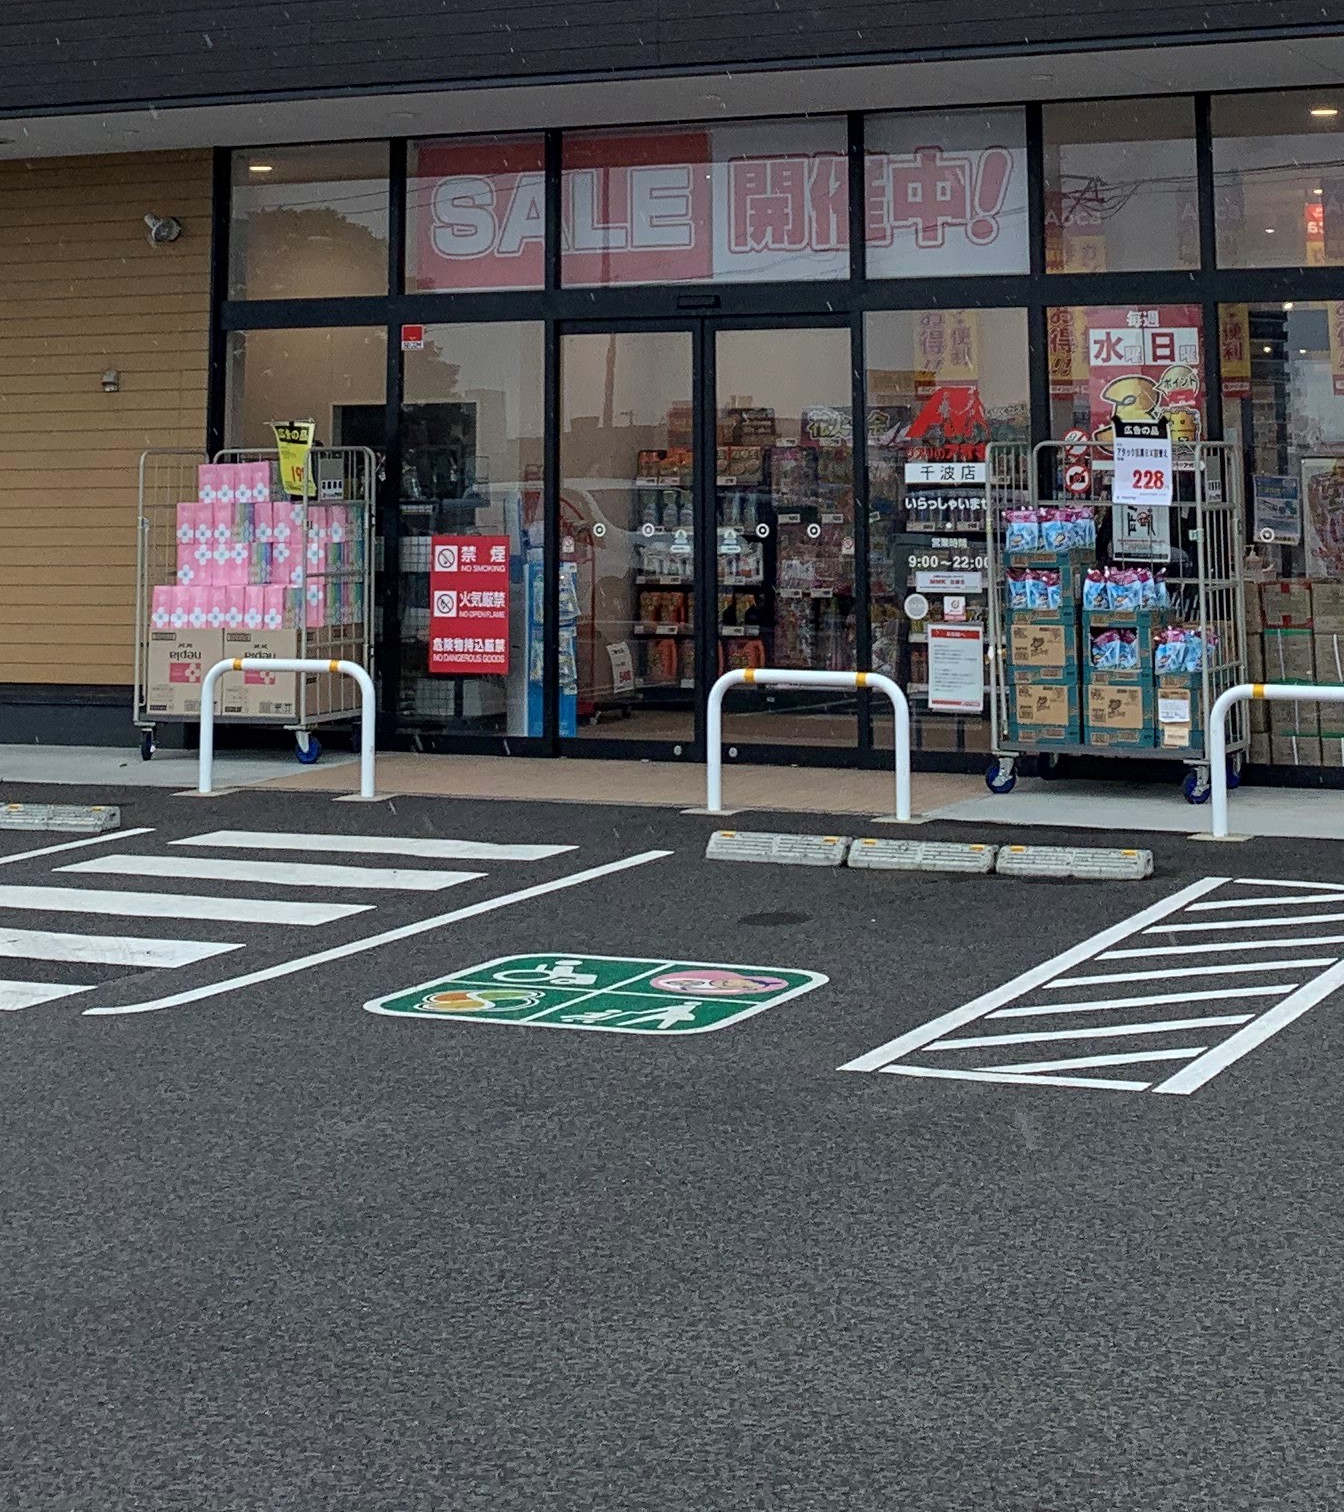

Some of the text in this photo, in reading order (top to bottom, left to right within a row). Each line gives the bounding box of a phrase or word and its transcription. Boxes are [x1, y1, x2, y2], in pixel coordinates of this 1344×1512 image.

[431, 162, 694, 260] SALE
[1126, 310, 1160, 329] 毎週
[1163, 375, 1198, 390] ポイント
[1123, 425, 1160, 436] 広告の品
[920, 465, 976, 481] 千波店
[1132, 469, 1164, 490] 228
[459, 591, 506, 608] 火気厳禁
[432, 637, 505, 653] 危険物持込厳禁
[433, 653, 442, 662] NO
